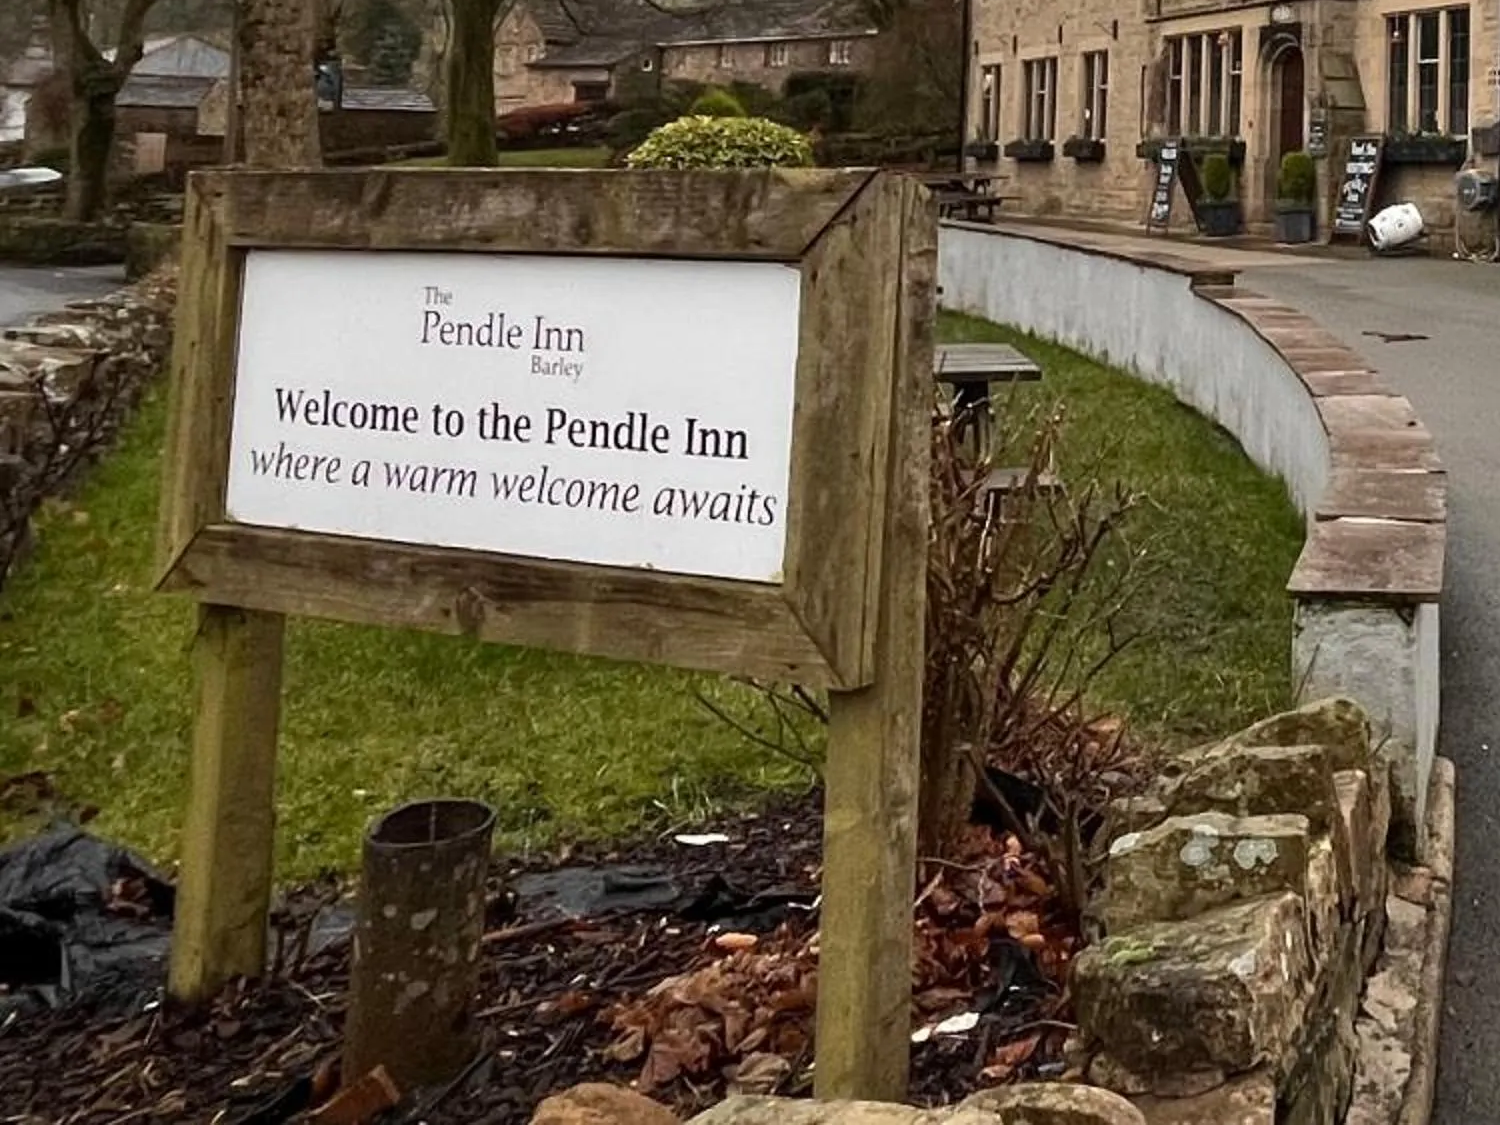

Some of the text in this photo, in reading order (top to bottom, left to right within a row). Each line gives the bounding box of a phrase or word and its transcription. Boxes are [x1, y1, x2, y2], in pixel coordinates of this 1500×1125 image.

[423, 285, 453, 306] The
[420, 310, 585, 353] Pendle Inn
[530, 355, 584, 380] Barley
[274, 387, 749, 460] Welcome to the Pendle Inn
[250, 442, 777, 527] where a warm welcome awaits
